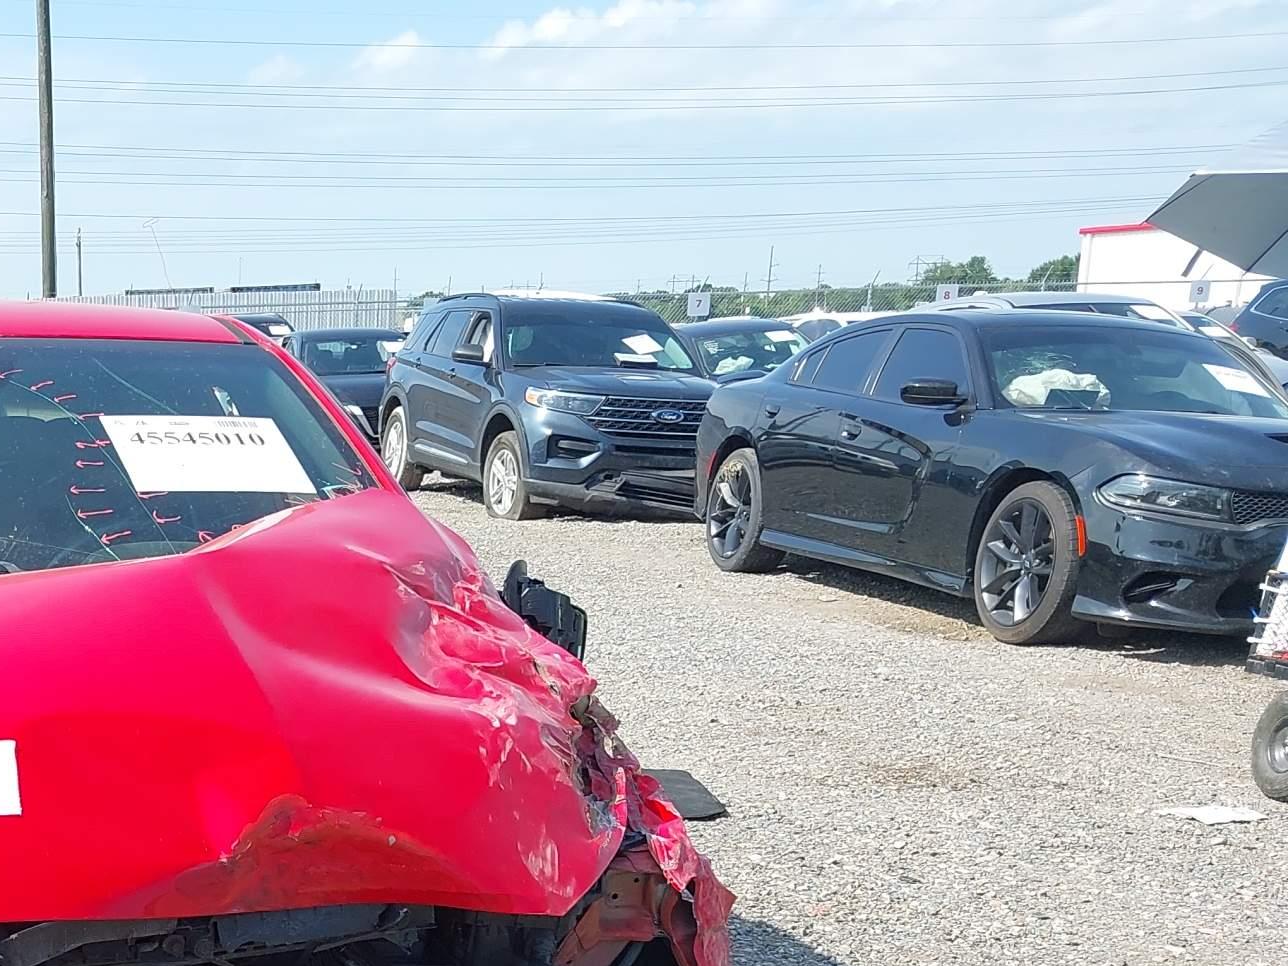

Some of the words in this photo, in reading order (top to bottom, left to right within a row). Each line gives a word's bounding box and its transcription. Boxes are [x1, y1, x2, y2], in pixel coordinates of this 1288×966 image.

[943, 290, 951, 300] 8
[1196, 286, 1204, 295] 9
[695, 299, 702, 308] 7
[129, 431, 266, 446] 45545010
